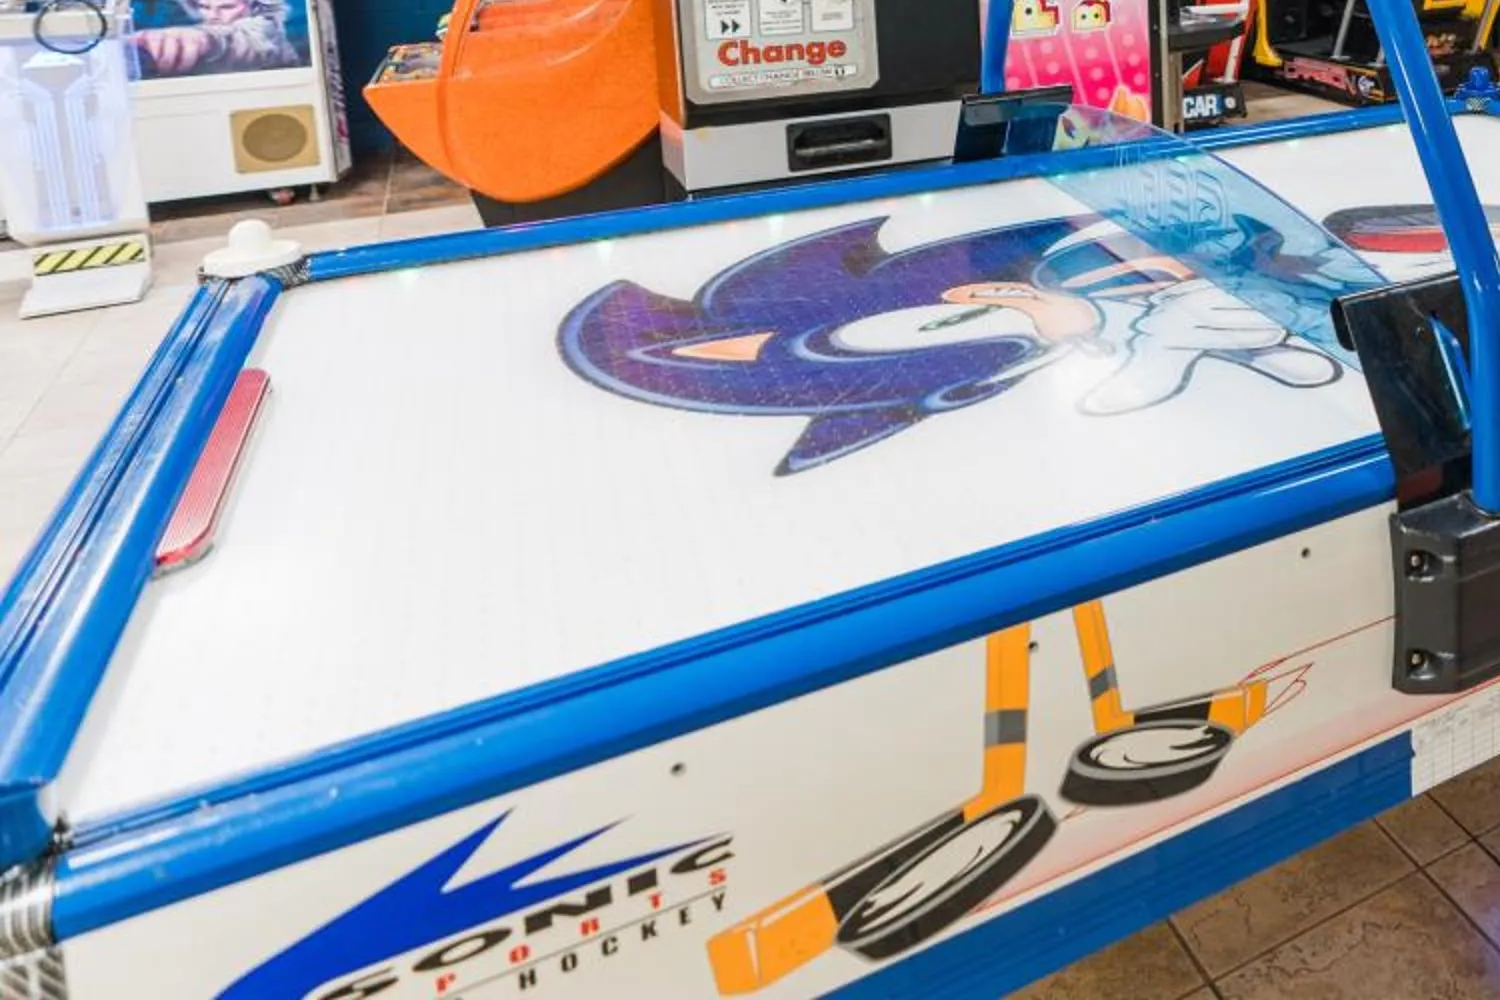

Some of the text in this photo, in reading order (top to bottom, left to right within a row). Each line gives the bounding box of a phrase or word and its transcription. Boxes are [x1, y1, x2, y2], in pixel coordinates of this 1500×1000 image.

[717, 39, 847, 67] Change
[316, 837, 735, 1000] SONIC
[435, 868, 727, 993] PORTS
[517, 892, 726, 991] HOCKEY
